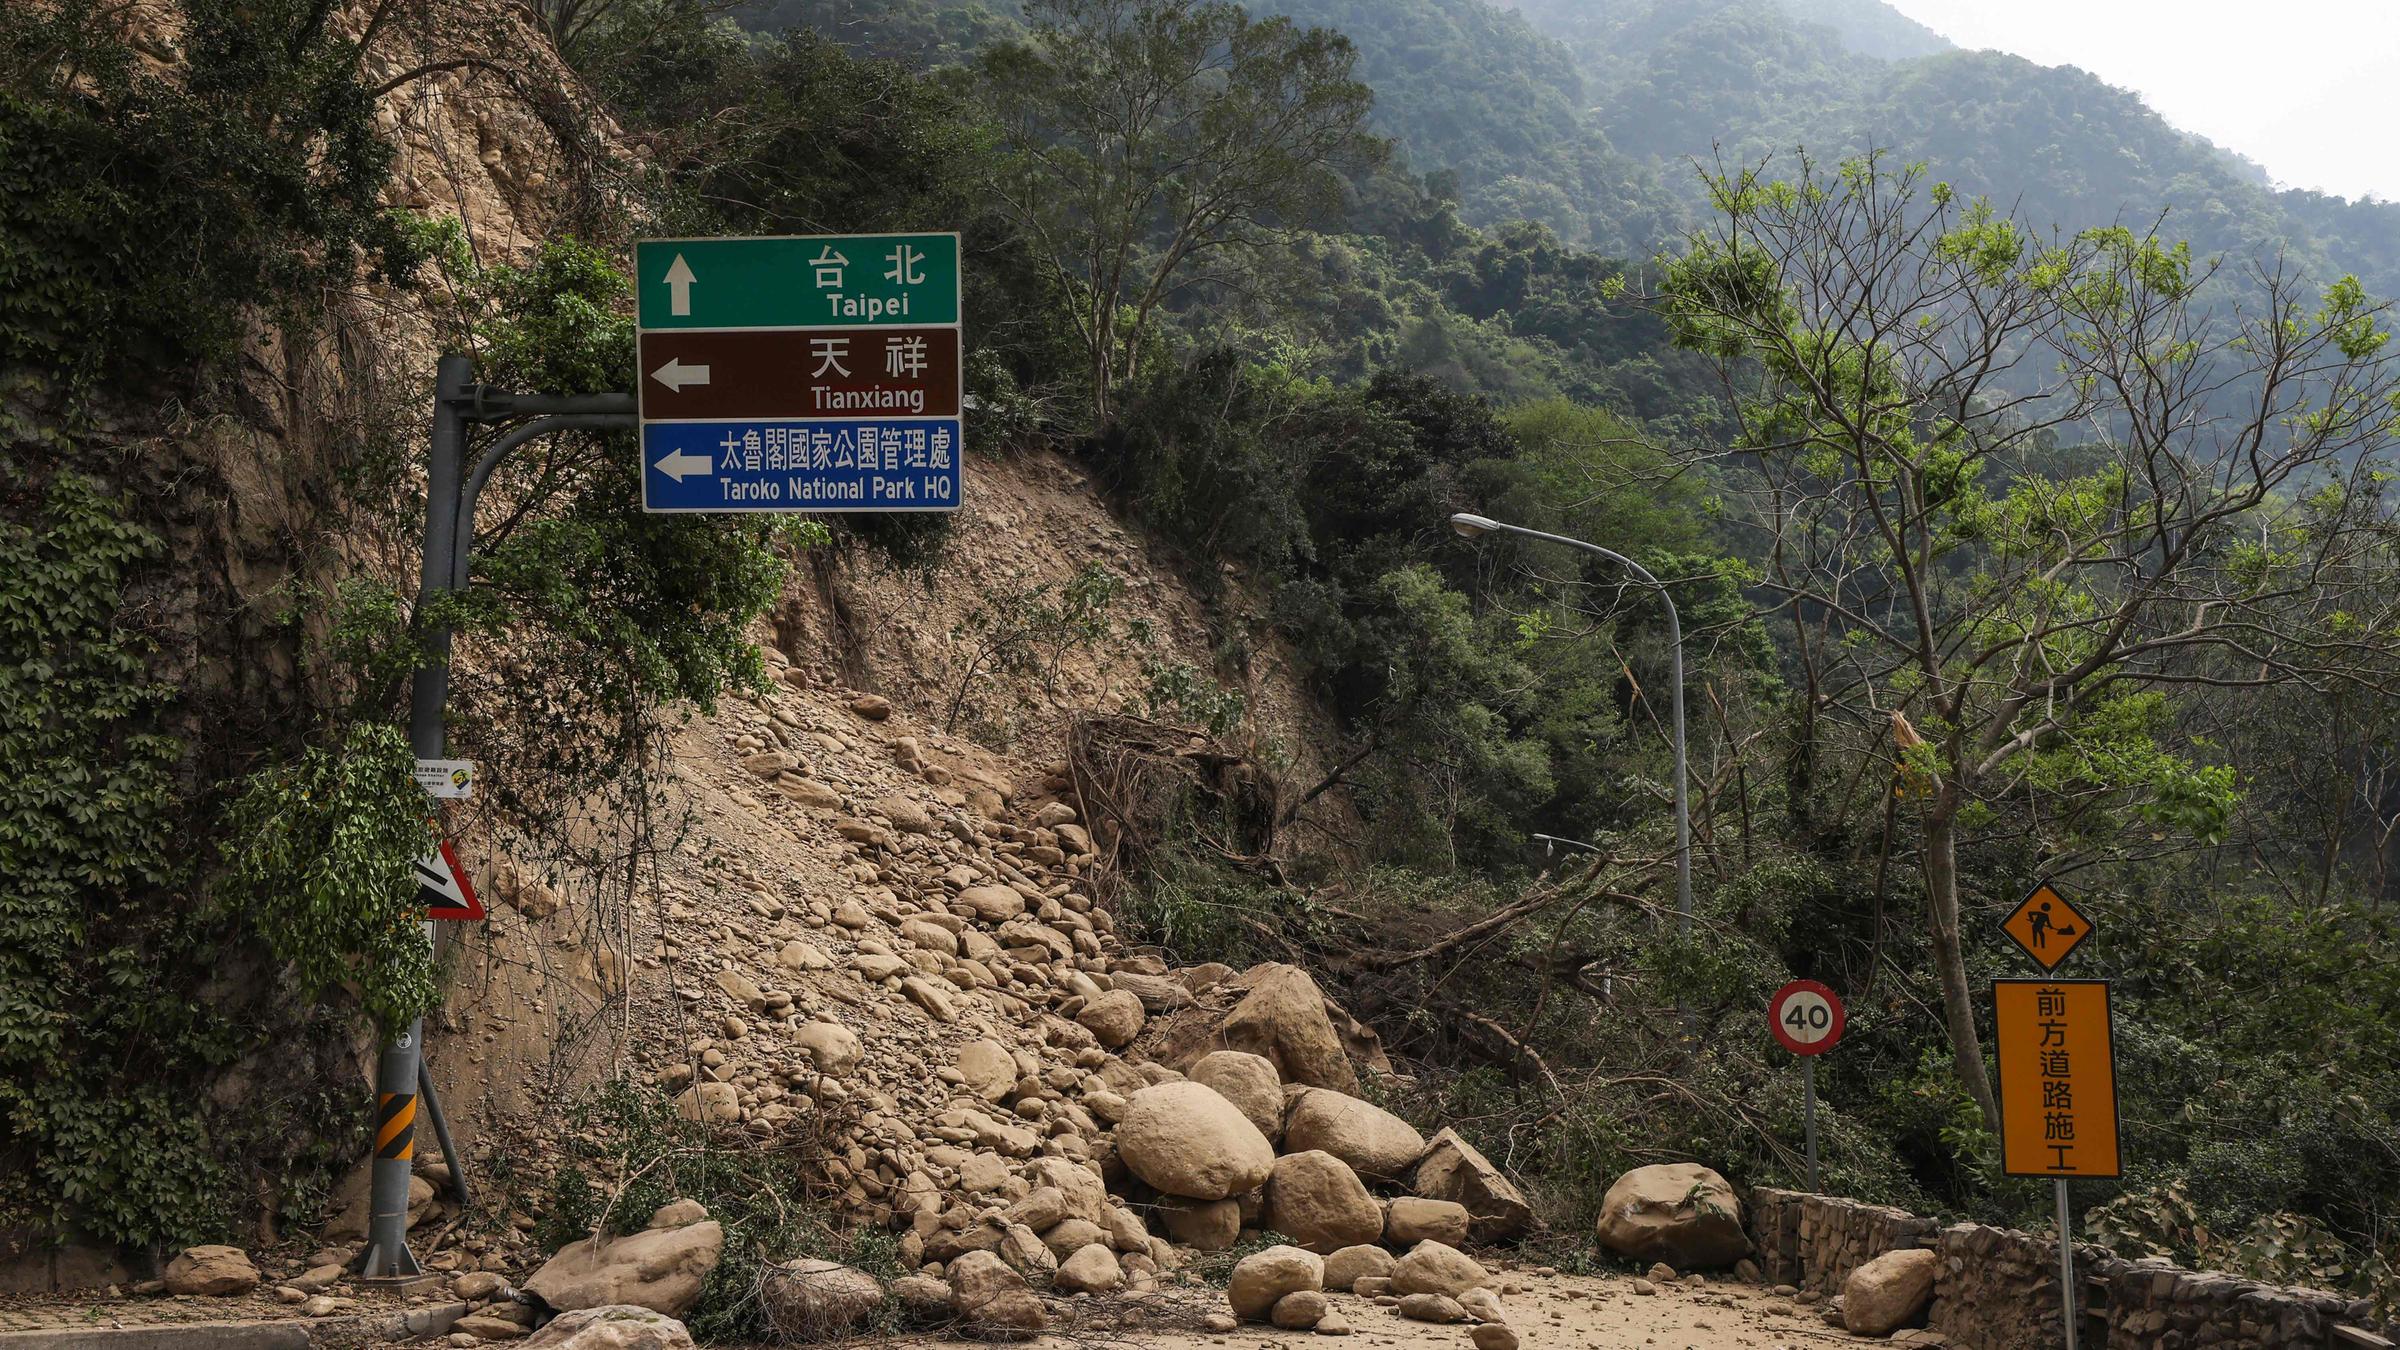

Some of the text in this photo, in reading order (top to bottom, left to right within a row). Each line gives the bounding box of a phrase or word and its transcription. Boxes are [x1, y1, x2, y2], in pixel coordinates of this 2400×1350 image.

[808, 245, 926, 289] 台北
[826, 292, 909, 322] Taipei
[809, 336, 928, 379] 天祥
[810, 385, 925, 413] Tianxiang
[719, 427, 951, 471] 太魯閣國家公園管理處
[720, 475, 951, 500] Taroko National Park HQ
[1784, 1004, 1830, 1031] 40
[2035, 987, 2078, 1171] 前方道路施工
